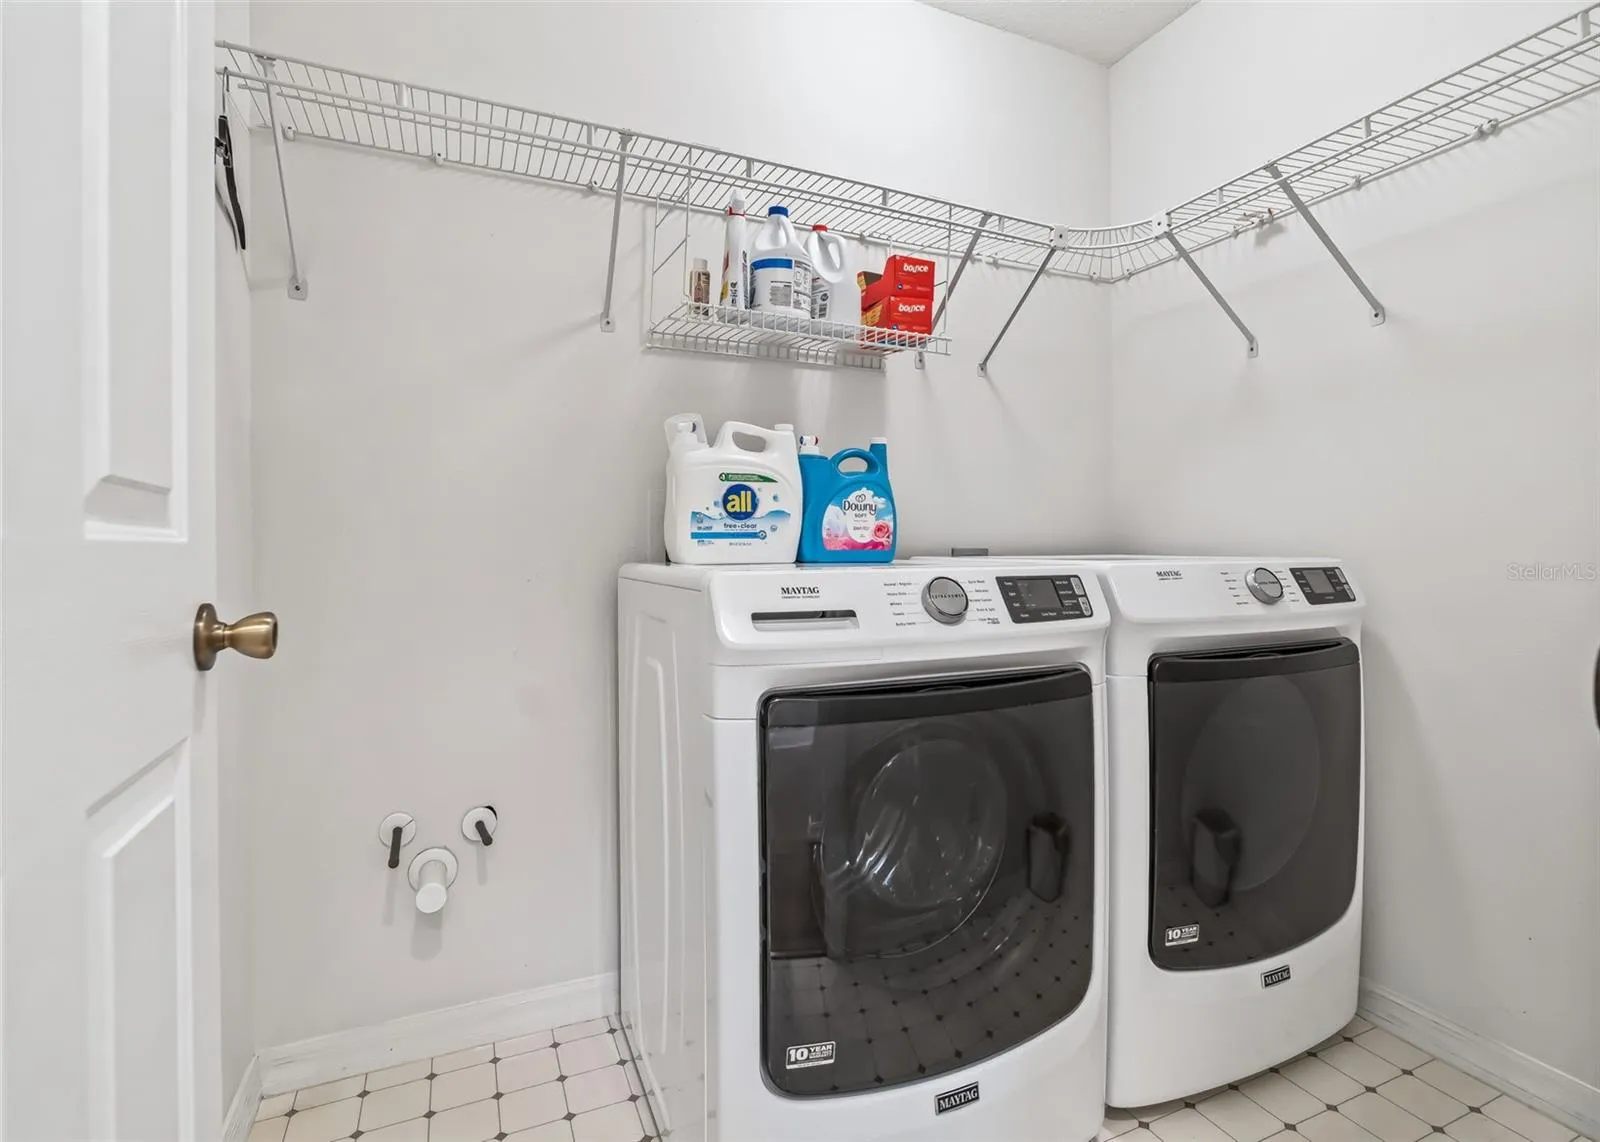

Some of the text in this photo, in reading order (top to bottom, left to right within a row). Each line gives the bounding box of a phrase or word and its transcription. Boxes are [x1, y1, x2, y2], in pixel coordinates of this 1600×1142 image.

[903, 263, 929, 273] bounce
[898, 303, 926, 313] bounce
[726, 490, 752, 513] all
[843, 500, 877, 516] Downy
[781, 586, 820, 595] MAYTAG
[1168, 929, 1181, 940] 10
[1264, 968, 1291, 985] MAYTAG
[789, 1047, 809, 1062] 10
[809, 1044, 833, 1053] YEAR
[939, 1087, 979, 1111] MAYTAG
